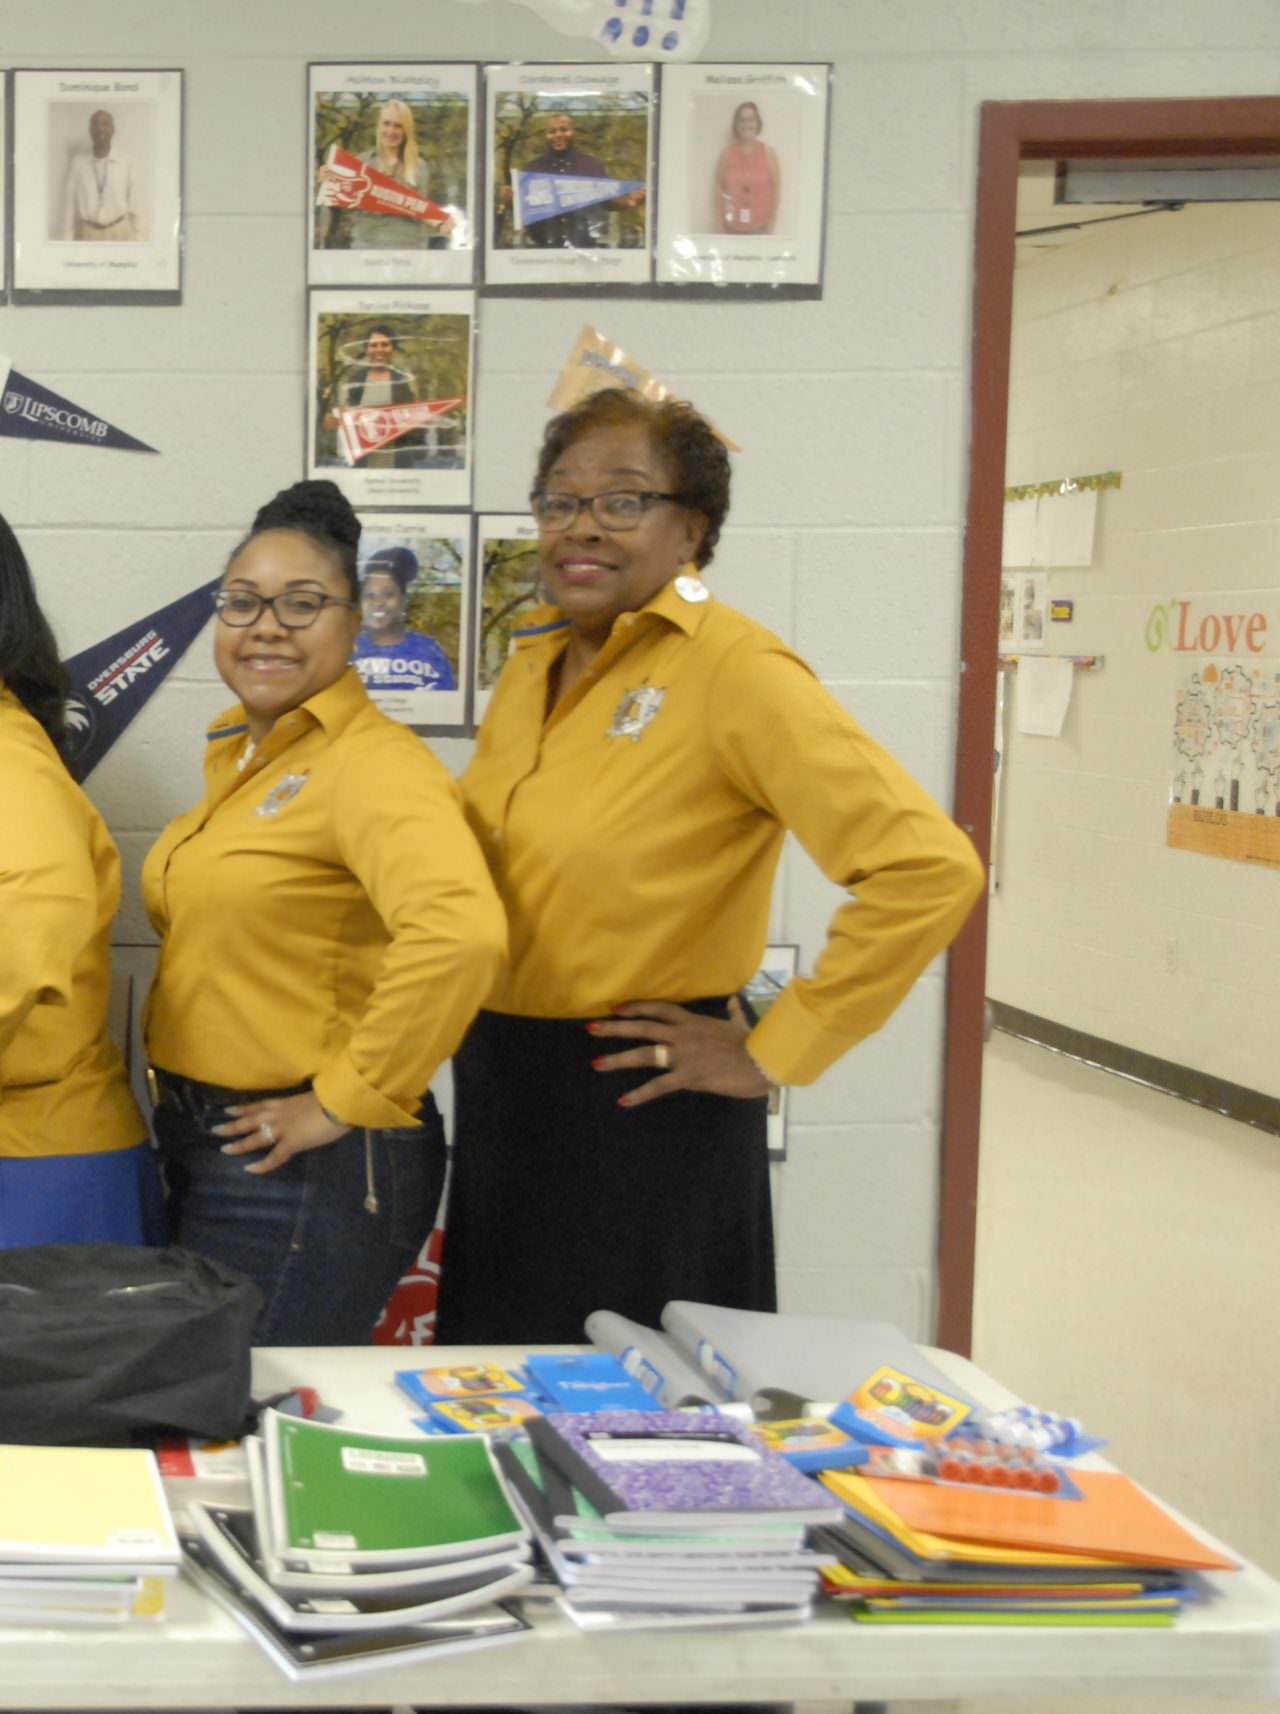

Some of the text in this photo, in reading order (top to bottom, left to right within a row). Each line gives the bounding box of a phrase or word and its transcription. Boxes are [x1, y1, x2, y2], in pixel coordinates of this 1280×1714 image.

[20, 397, 109, 437] LIPSCOMB
[1174, 600, 1268, 653] Love
[93, 638, 171, 707] STATE
